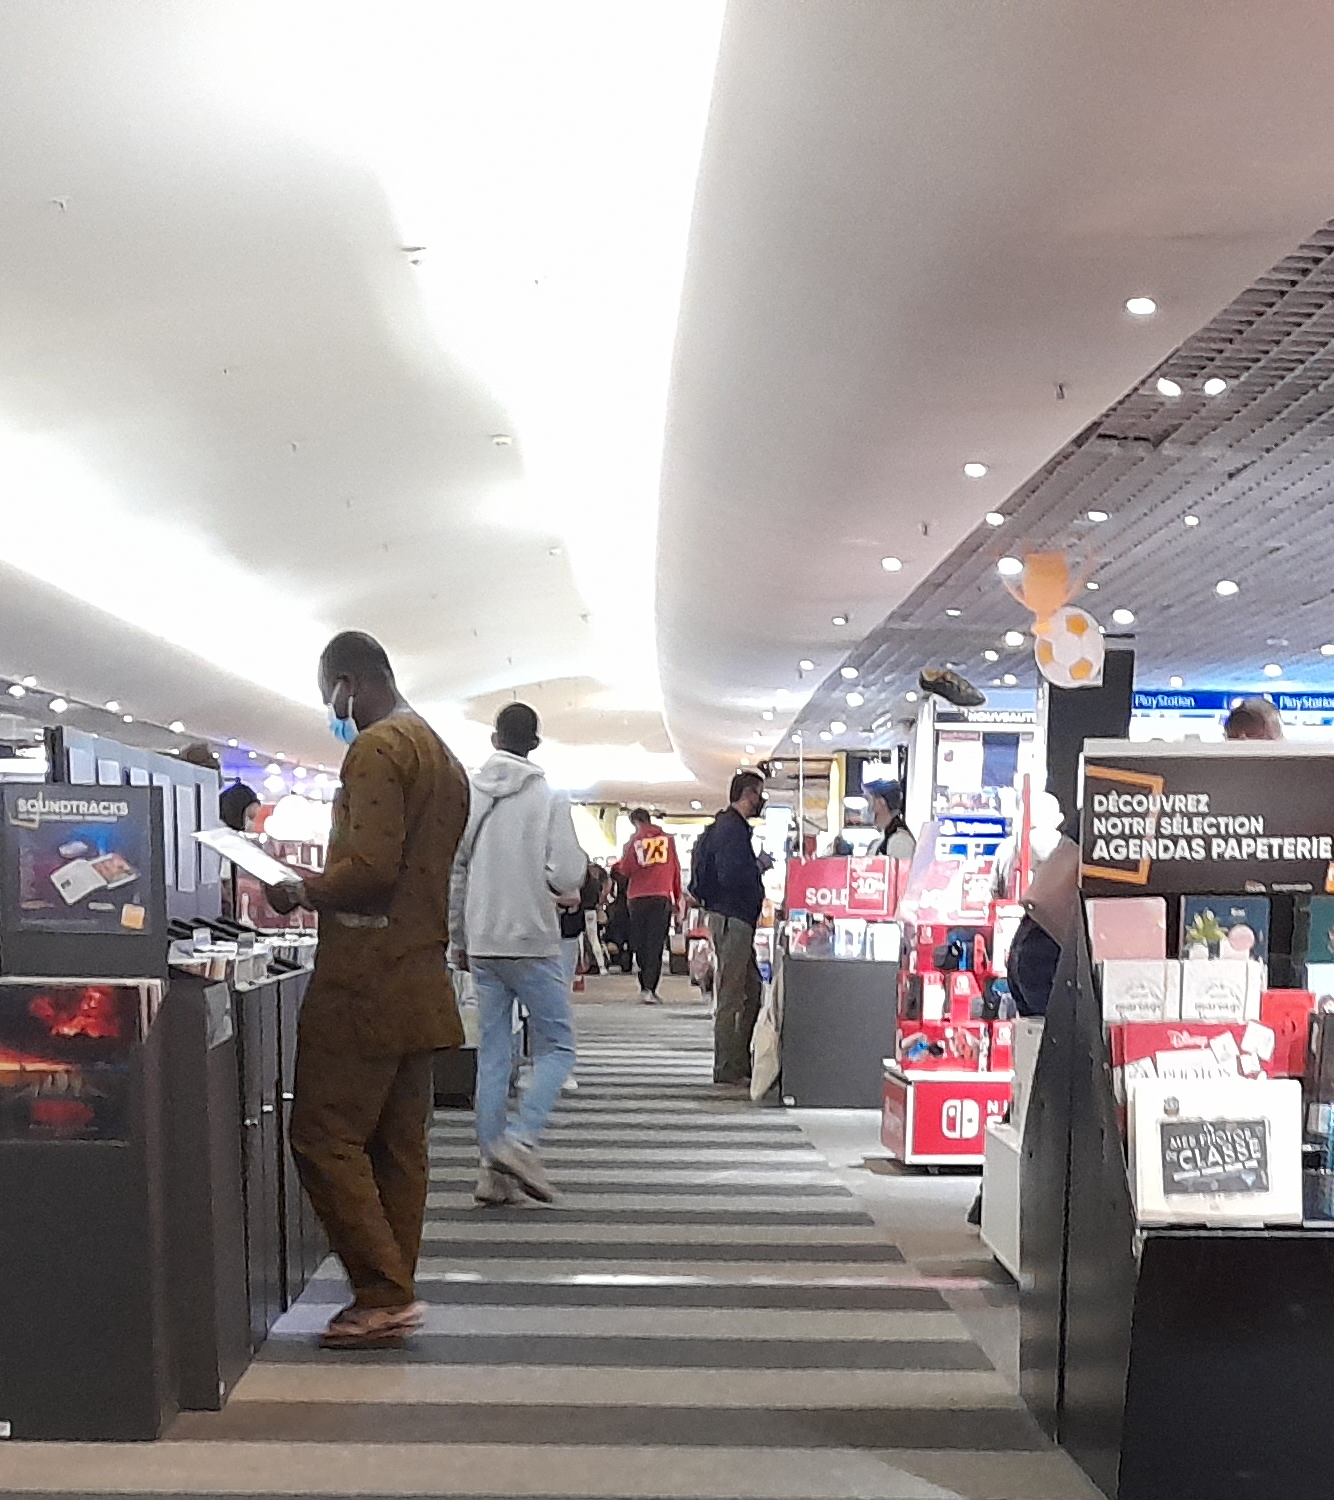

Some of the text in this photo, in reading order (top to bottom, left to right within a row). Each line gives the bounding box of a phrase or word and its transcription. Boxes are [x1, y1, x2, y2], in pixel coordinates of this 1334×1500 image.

[1135, 694, 1195, 709] PlayStation
[17, 799, 128, 816] SOUNDTRACKS
[1092, 790, 1210, 813] DÉCOUVREZ
[1093, 814, 1264, 836] NOTRE SÉLECTION
[1092, 835, 1333, 861] AGENDAS PAPETERIE
